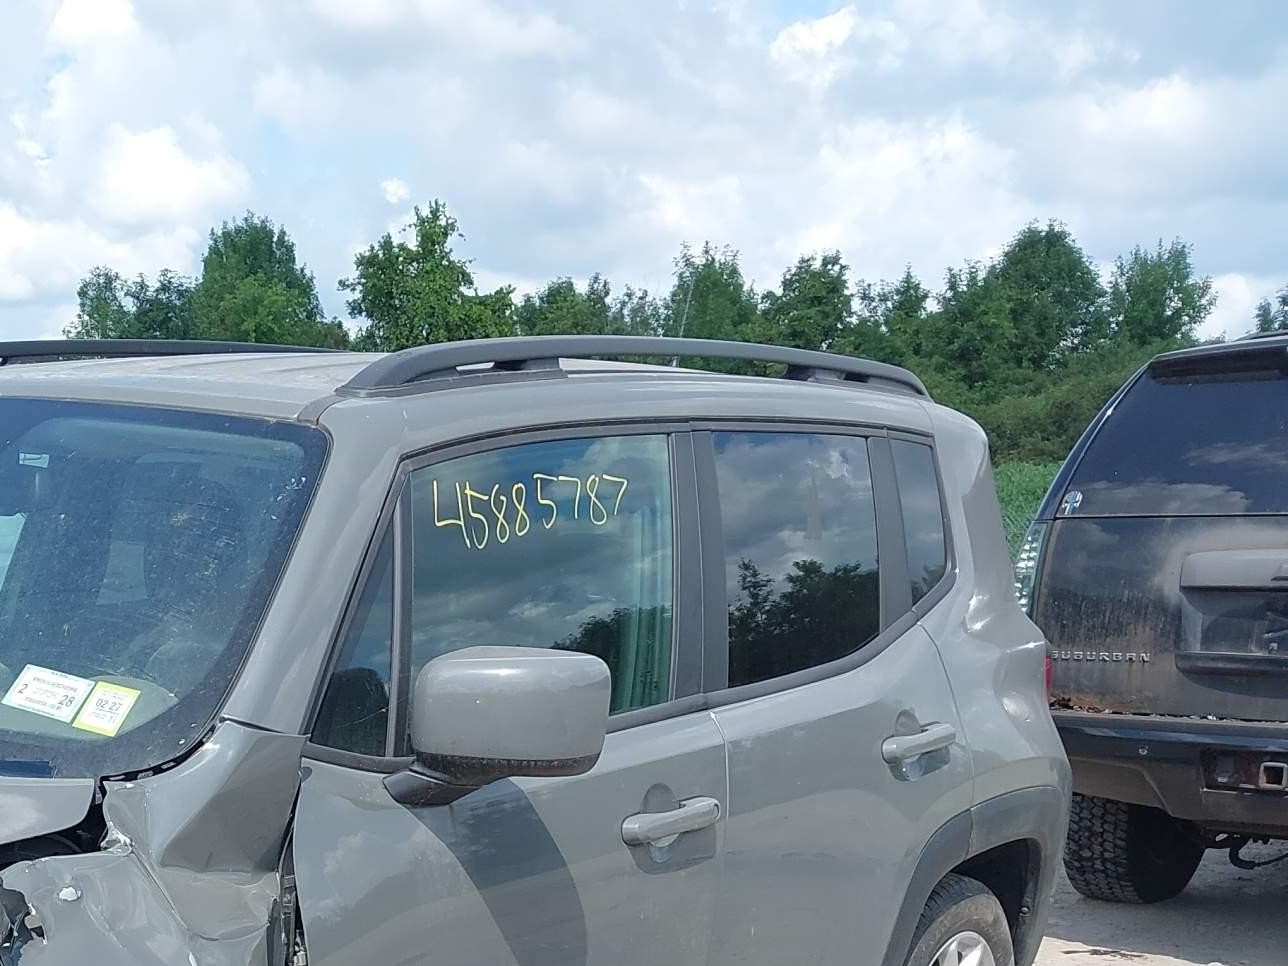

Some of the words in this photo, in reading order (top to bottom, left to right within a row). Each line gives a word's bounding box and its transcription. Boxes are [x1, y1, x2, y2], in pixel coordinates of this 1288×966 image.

[432, 473, 629, 549] 45885787
[1051, 650, 1151, 663] SUBURBAN
[57, 693, 76, 708] 28
